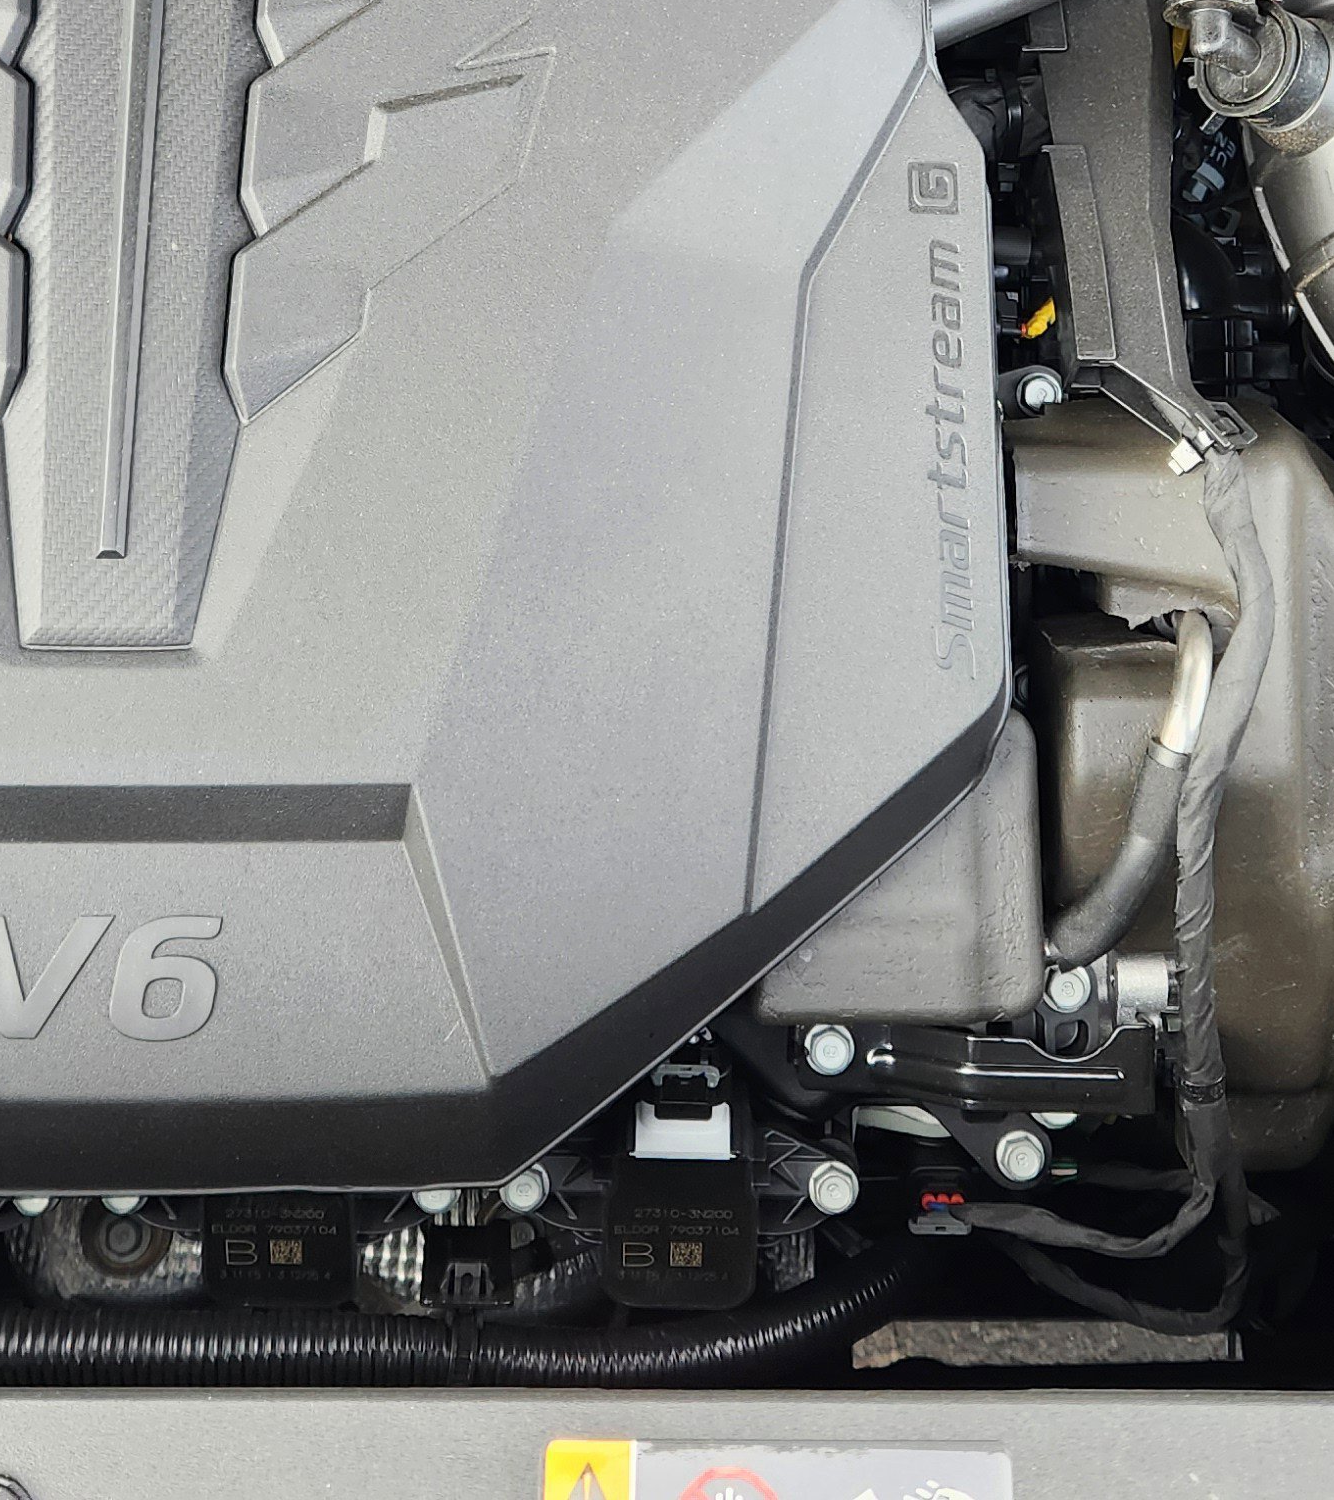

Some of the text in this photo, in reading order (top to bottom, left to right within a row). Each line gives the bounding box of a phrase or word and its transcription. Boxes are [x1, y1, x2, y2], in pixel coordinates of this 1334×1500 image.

[928, 238, 977, 678] Smartstream
[225, 1239, 258, 1266] B
[622, 1241, 655, 1268] B
